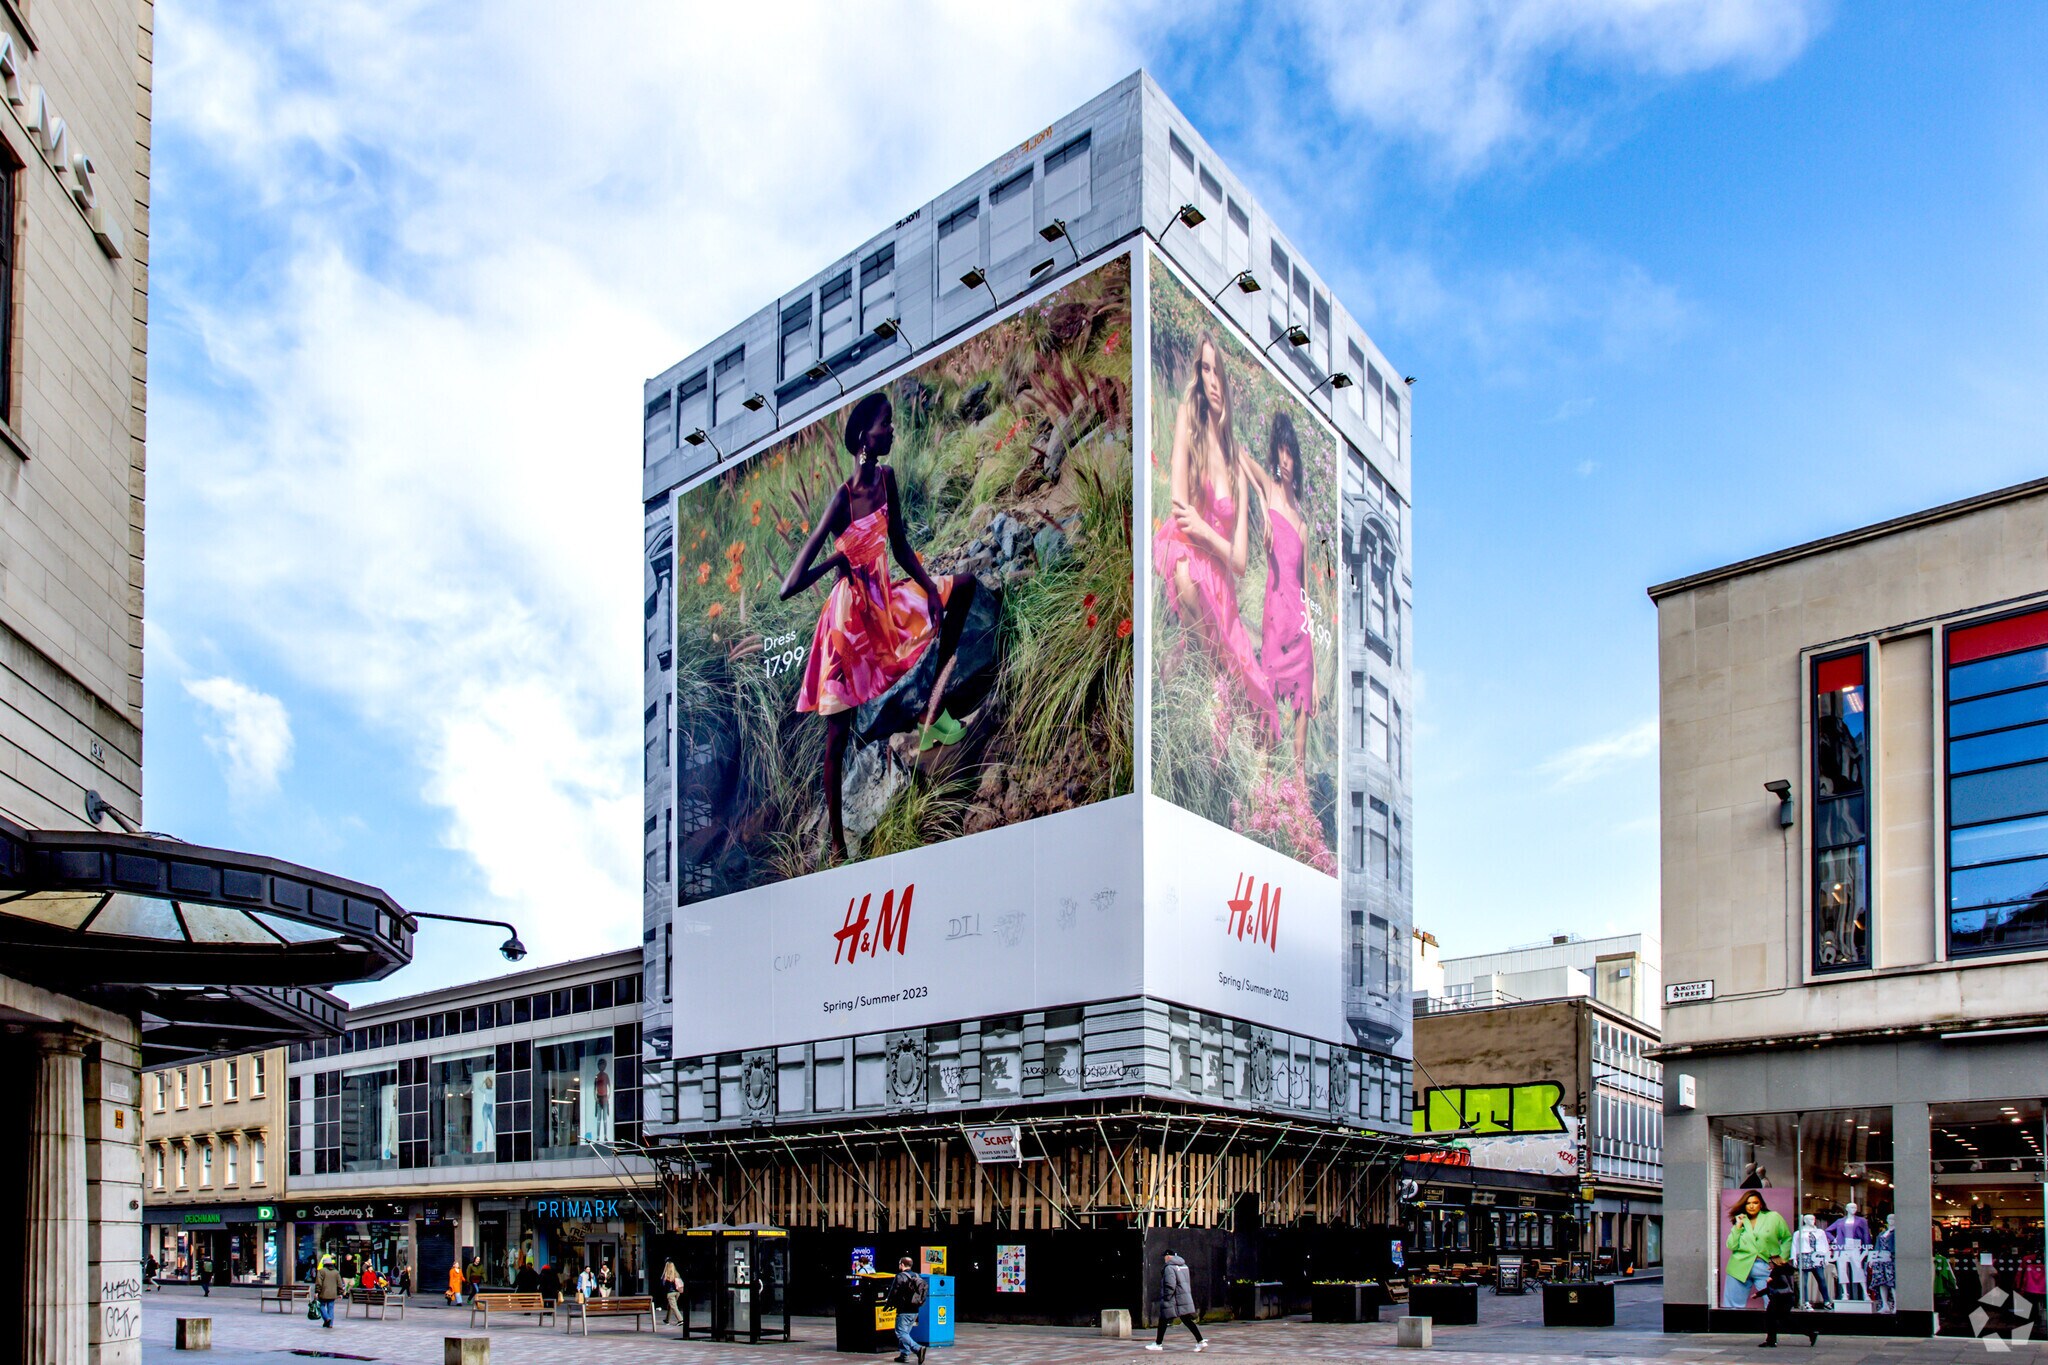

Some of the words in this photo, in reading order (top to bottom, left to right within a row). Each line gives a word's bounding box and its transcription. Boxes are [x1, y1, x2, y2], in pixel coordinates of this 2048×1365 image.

[1300, 587, 1322, 616] Dress
[1300, 611, 1332, 650] 24.99
[763, 630, 797, 652] Dress
[763, 645, 805, 679] 17.99
[1227, 871, 1282, 954] H&M
[833, 883, 915, 966] H&M
[902, 985, 928, 1001] 2023
[1273, 987, 1290, 1002] 2023
[1673, 983, 1707, 992] ARGYLE
[1673, 989, 1707, 998] STREET
[313, 1204, 363, 1219] Superdrug
[537, 1199, 619, 1218] PRIMARK
[184, 1213, 221, 1224] DEICHMANN
